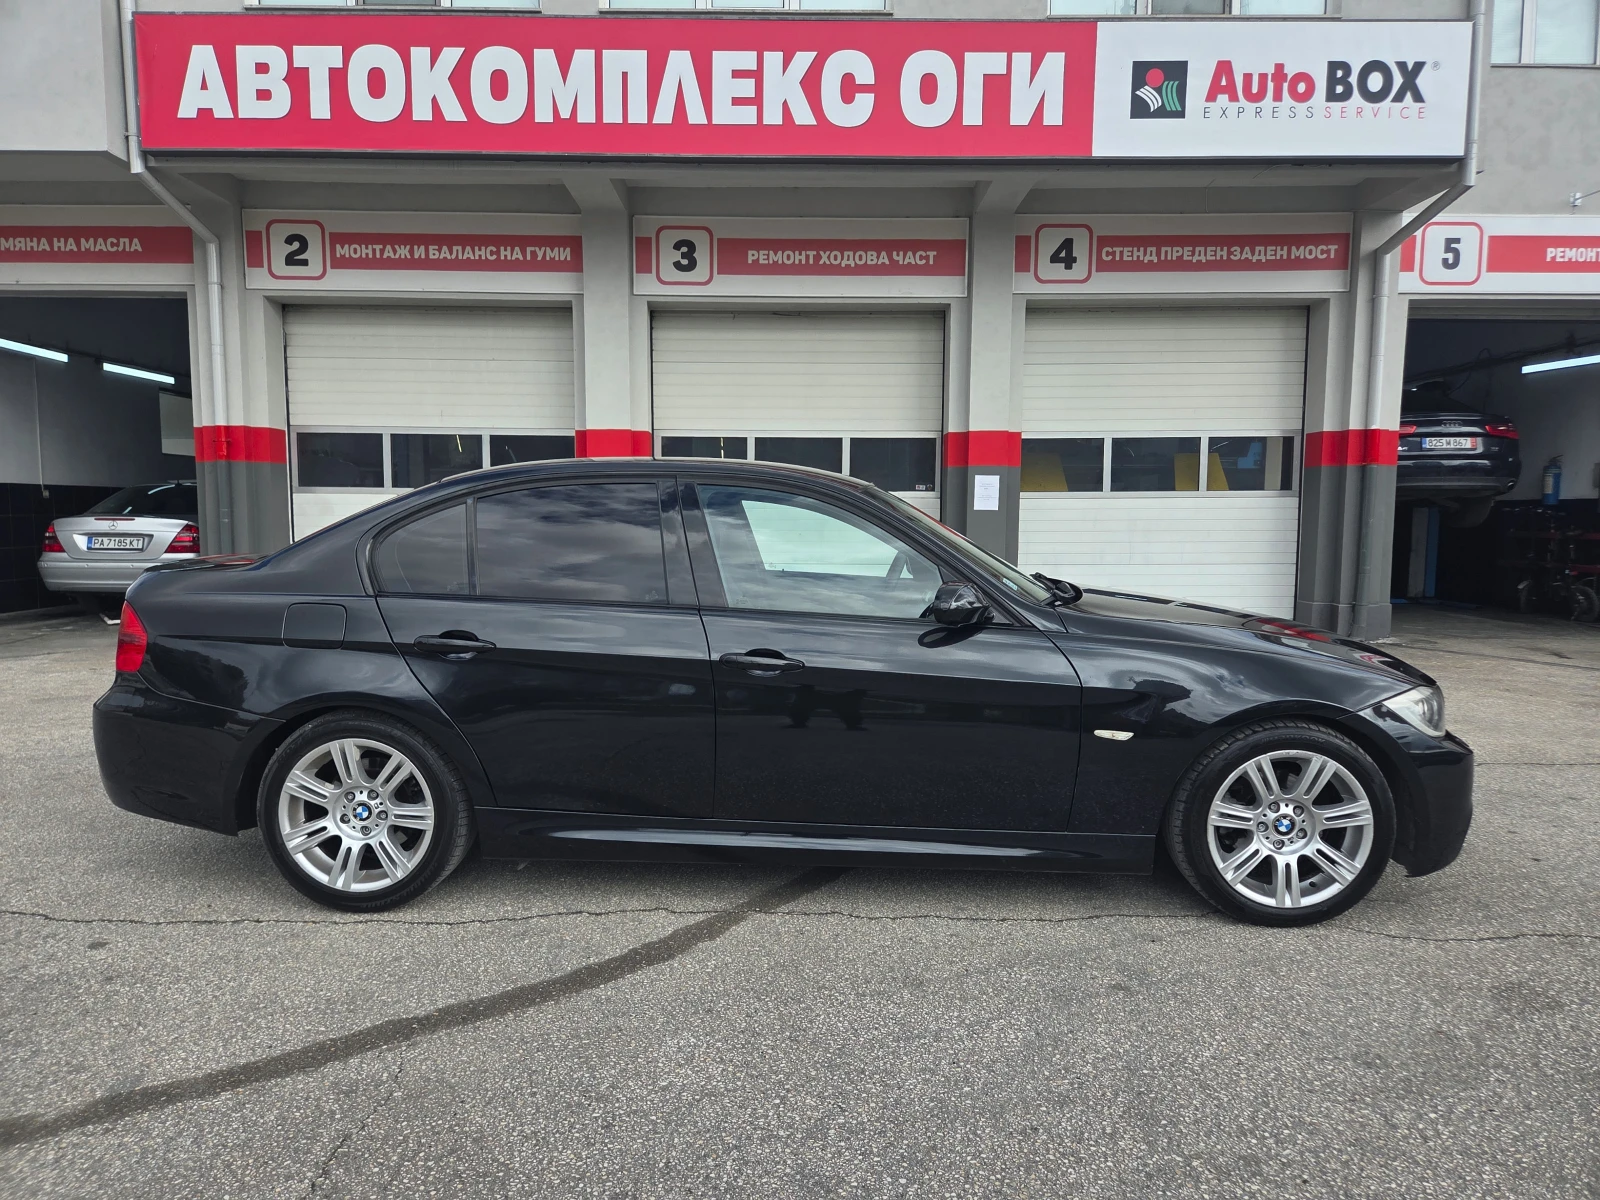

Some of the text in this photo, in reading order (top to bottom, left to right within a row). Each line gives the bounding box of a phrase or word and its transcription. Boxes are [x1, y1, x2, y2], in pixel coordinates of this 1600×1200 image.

[177, 44, 1066, 128] АВТОКОМПЛЕКС ОГИ
[1204, 60, 1316, 104] Auto
[1203, 106, 1427, 119] EXPRESS SERVICE
[53, 237, 78, 252] НА
[81, 237, 143, 252] МАСЛА
[284, 233, 309, 267] 2
[336, 243, 571, 261] МОНТАЖ И БАЛАНС НА ГУМИ
[672, 239, 697, 273] 3
[747, 250, 937, 267] РЕМОНТ ХОДОВА ЧАСТ
[1050, 238, 1077, 270] 4
[1101, 244, 1338, 263] СТЕНД ПРЕДЕН ЗАДЕН МОСТ
[1441, 237, 1461, 270] 5
